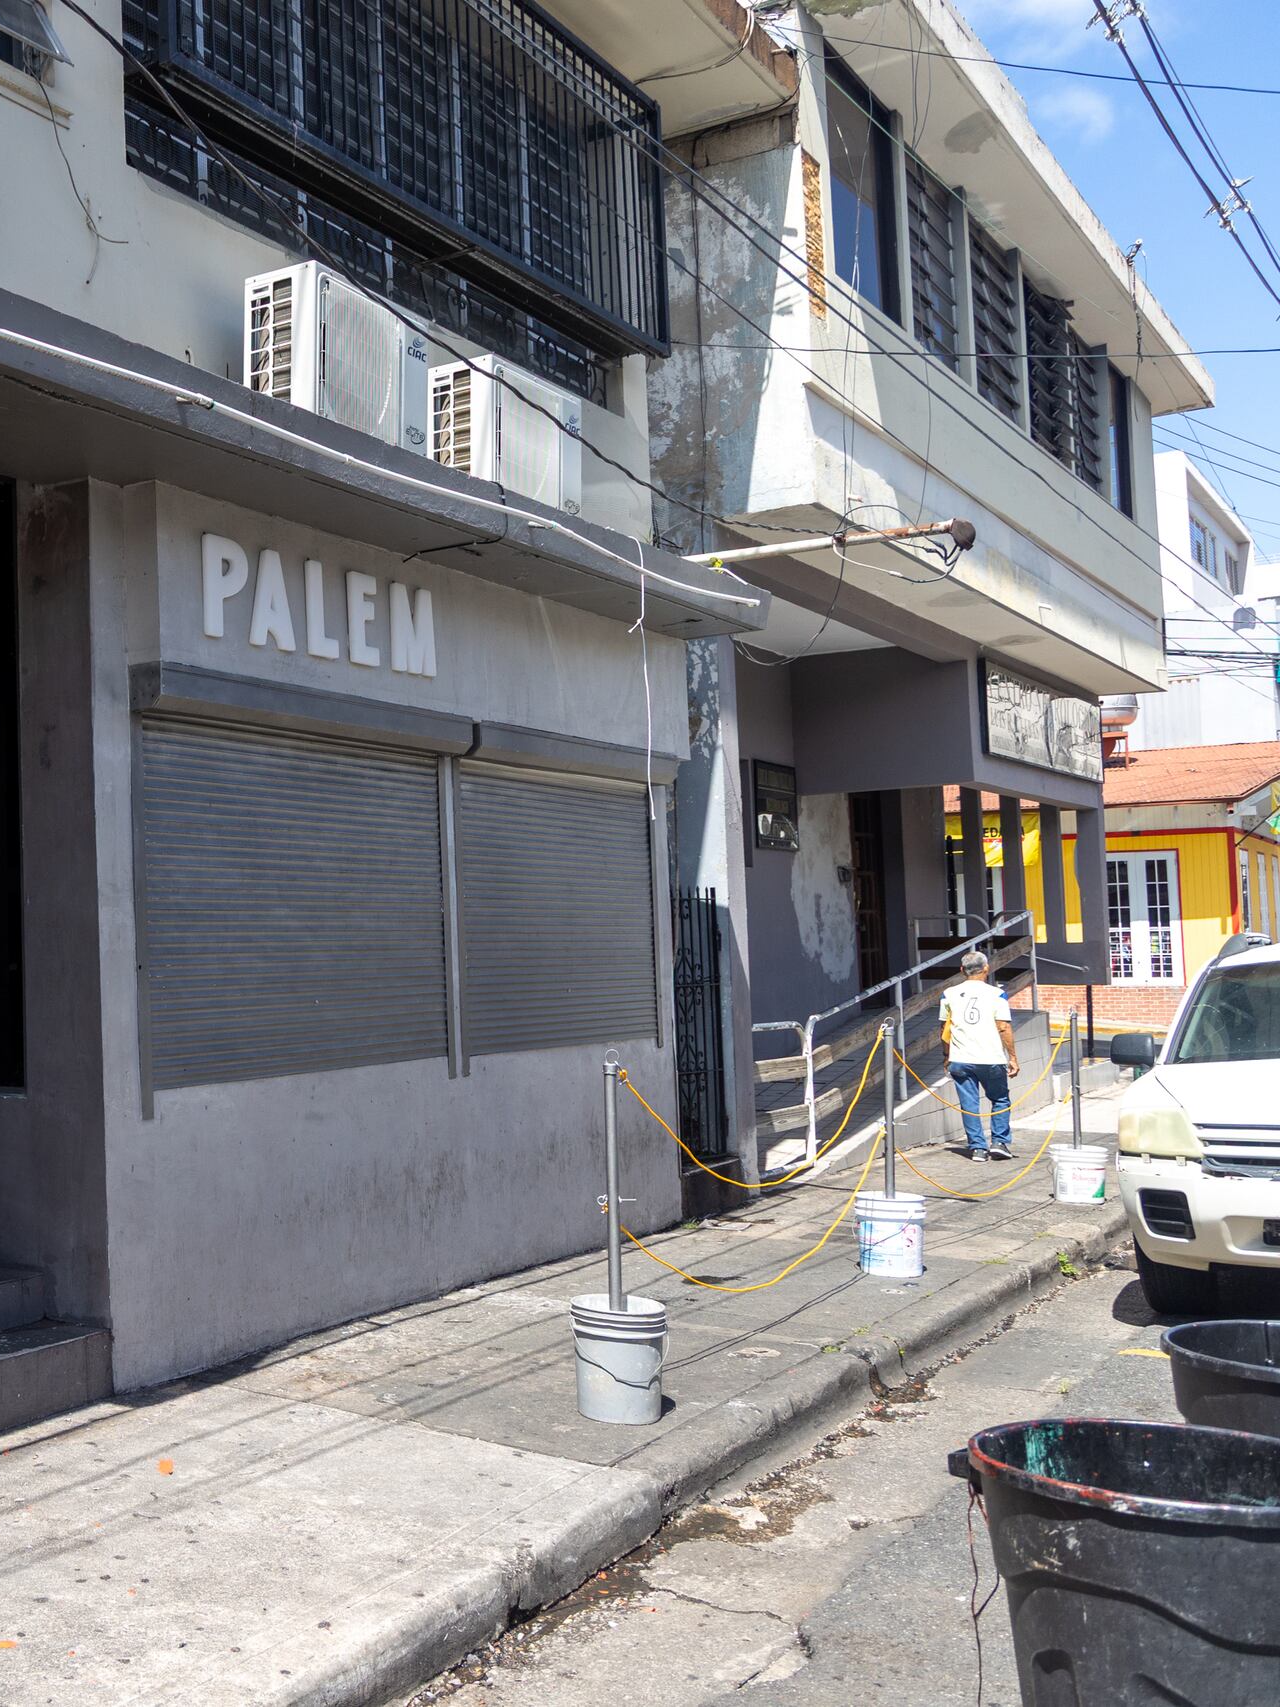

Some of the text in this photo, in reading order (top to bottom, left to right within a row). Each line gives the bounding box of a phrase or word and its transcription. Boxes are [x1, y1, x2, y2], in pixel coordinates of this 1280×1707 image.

[407, 346, 427, 363] CIAC
[202, 533, 437, 678] PALEM
[963, 996, 980, 1025] 6
